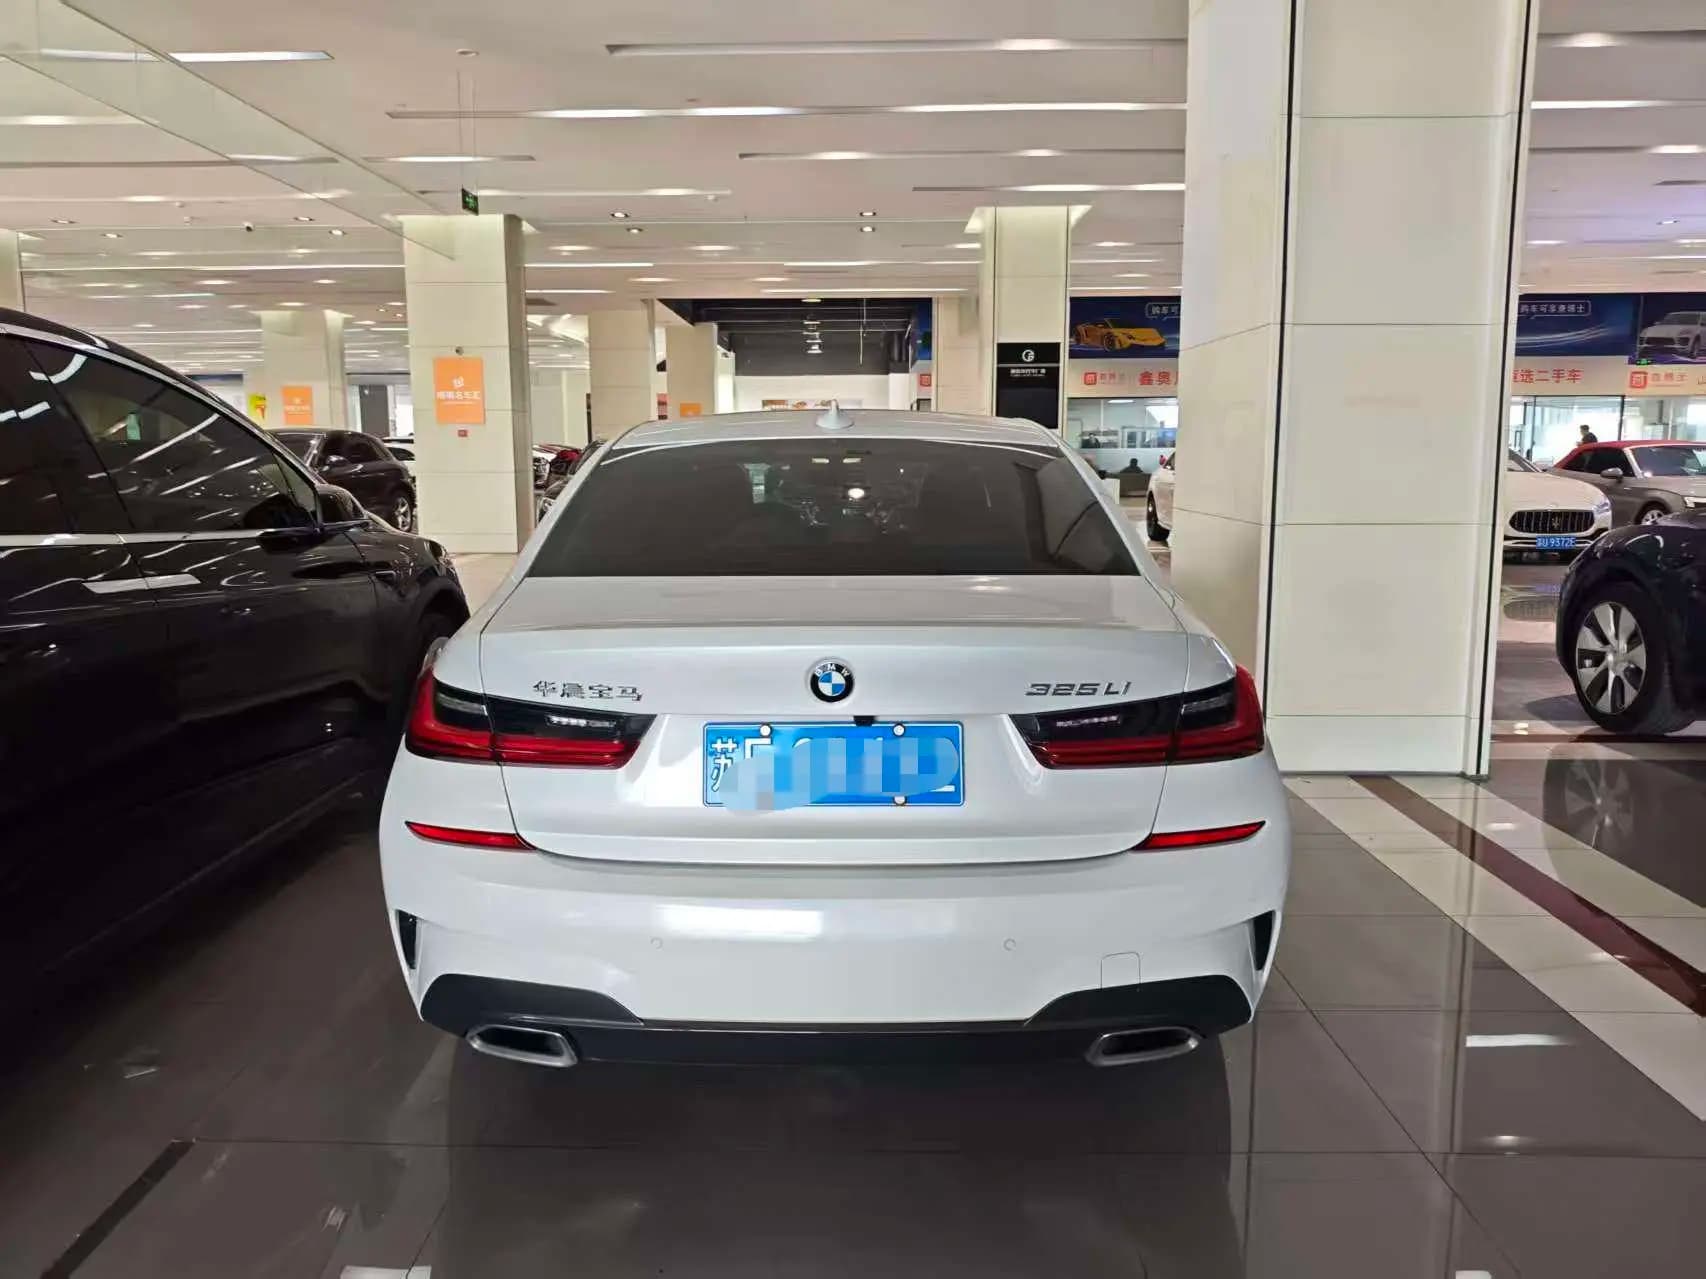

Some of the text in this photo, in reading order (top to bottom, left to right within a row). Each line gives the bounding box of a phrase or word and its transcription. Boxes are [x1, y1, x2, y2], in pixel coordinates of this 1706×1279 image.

[1140, 370, 1178, 386] 鑫奥
[815, 663, 850, 677] BMW
[533, 680, 642, 701] 华晨宝马
